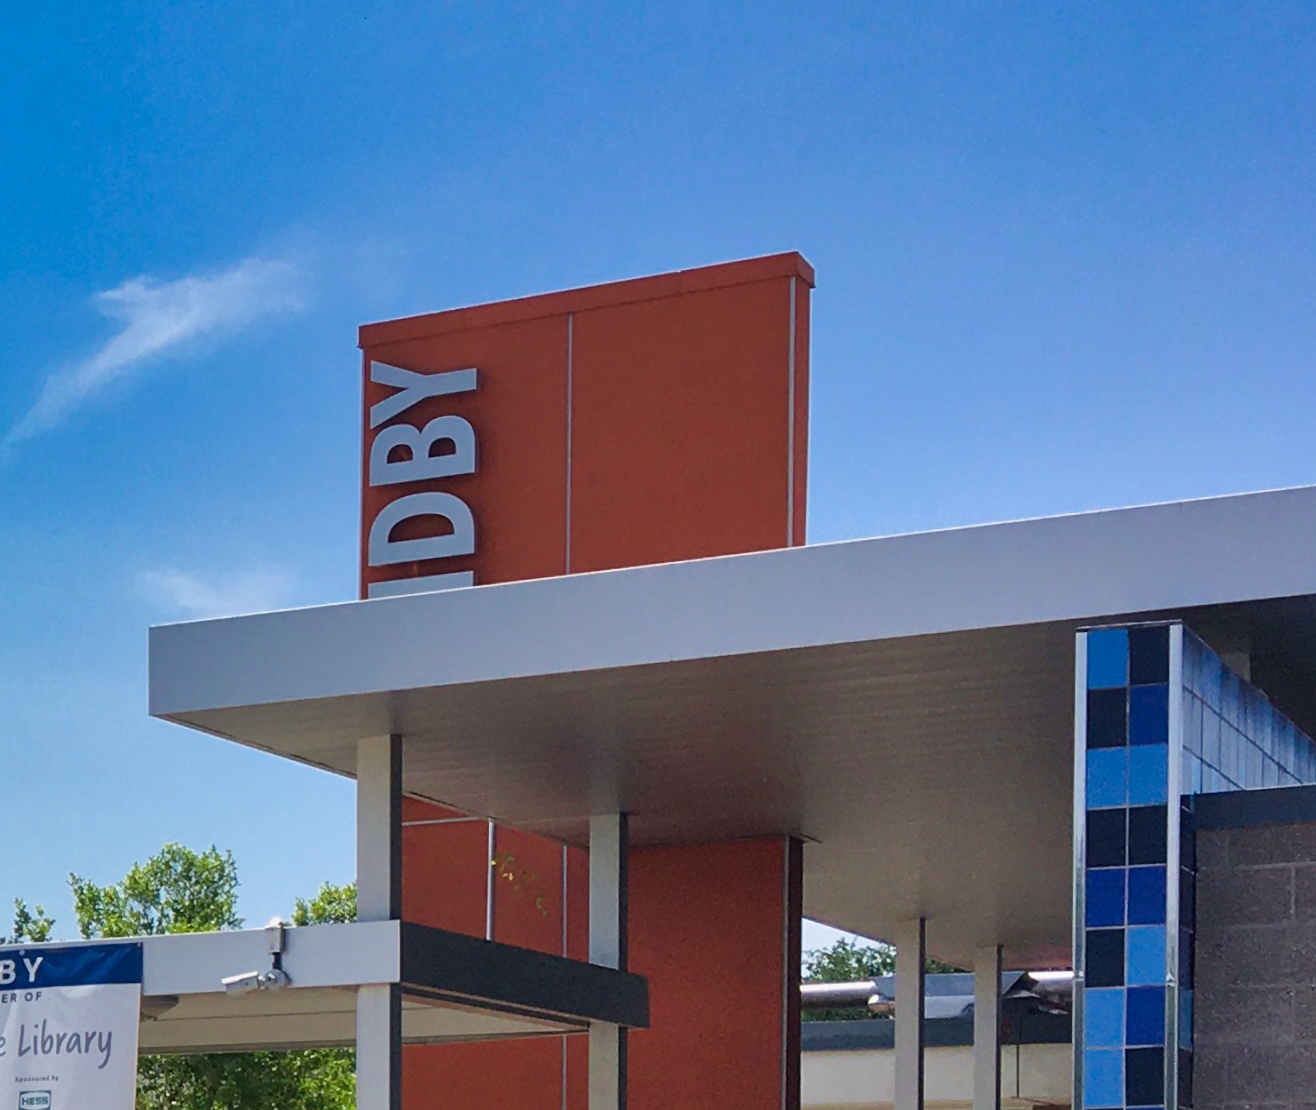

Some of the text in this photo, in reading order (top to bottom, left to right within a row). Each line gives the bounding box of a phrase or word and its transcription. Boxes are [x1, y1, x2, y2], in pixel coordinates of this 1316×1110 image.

[24, 991, 43, 1002] OF
[17, 1018, 113, 1070] Library
[51, 1075, 60, 1083] by
[21, 1096, 49, 1106] HESS
